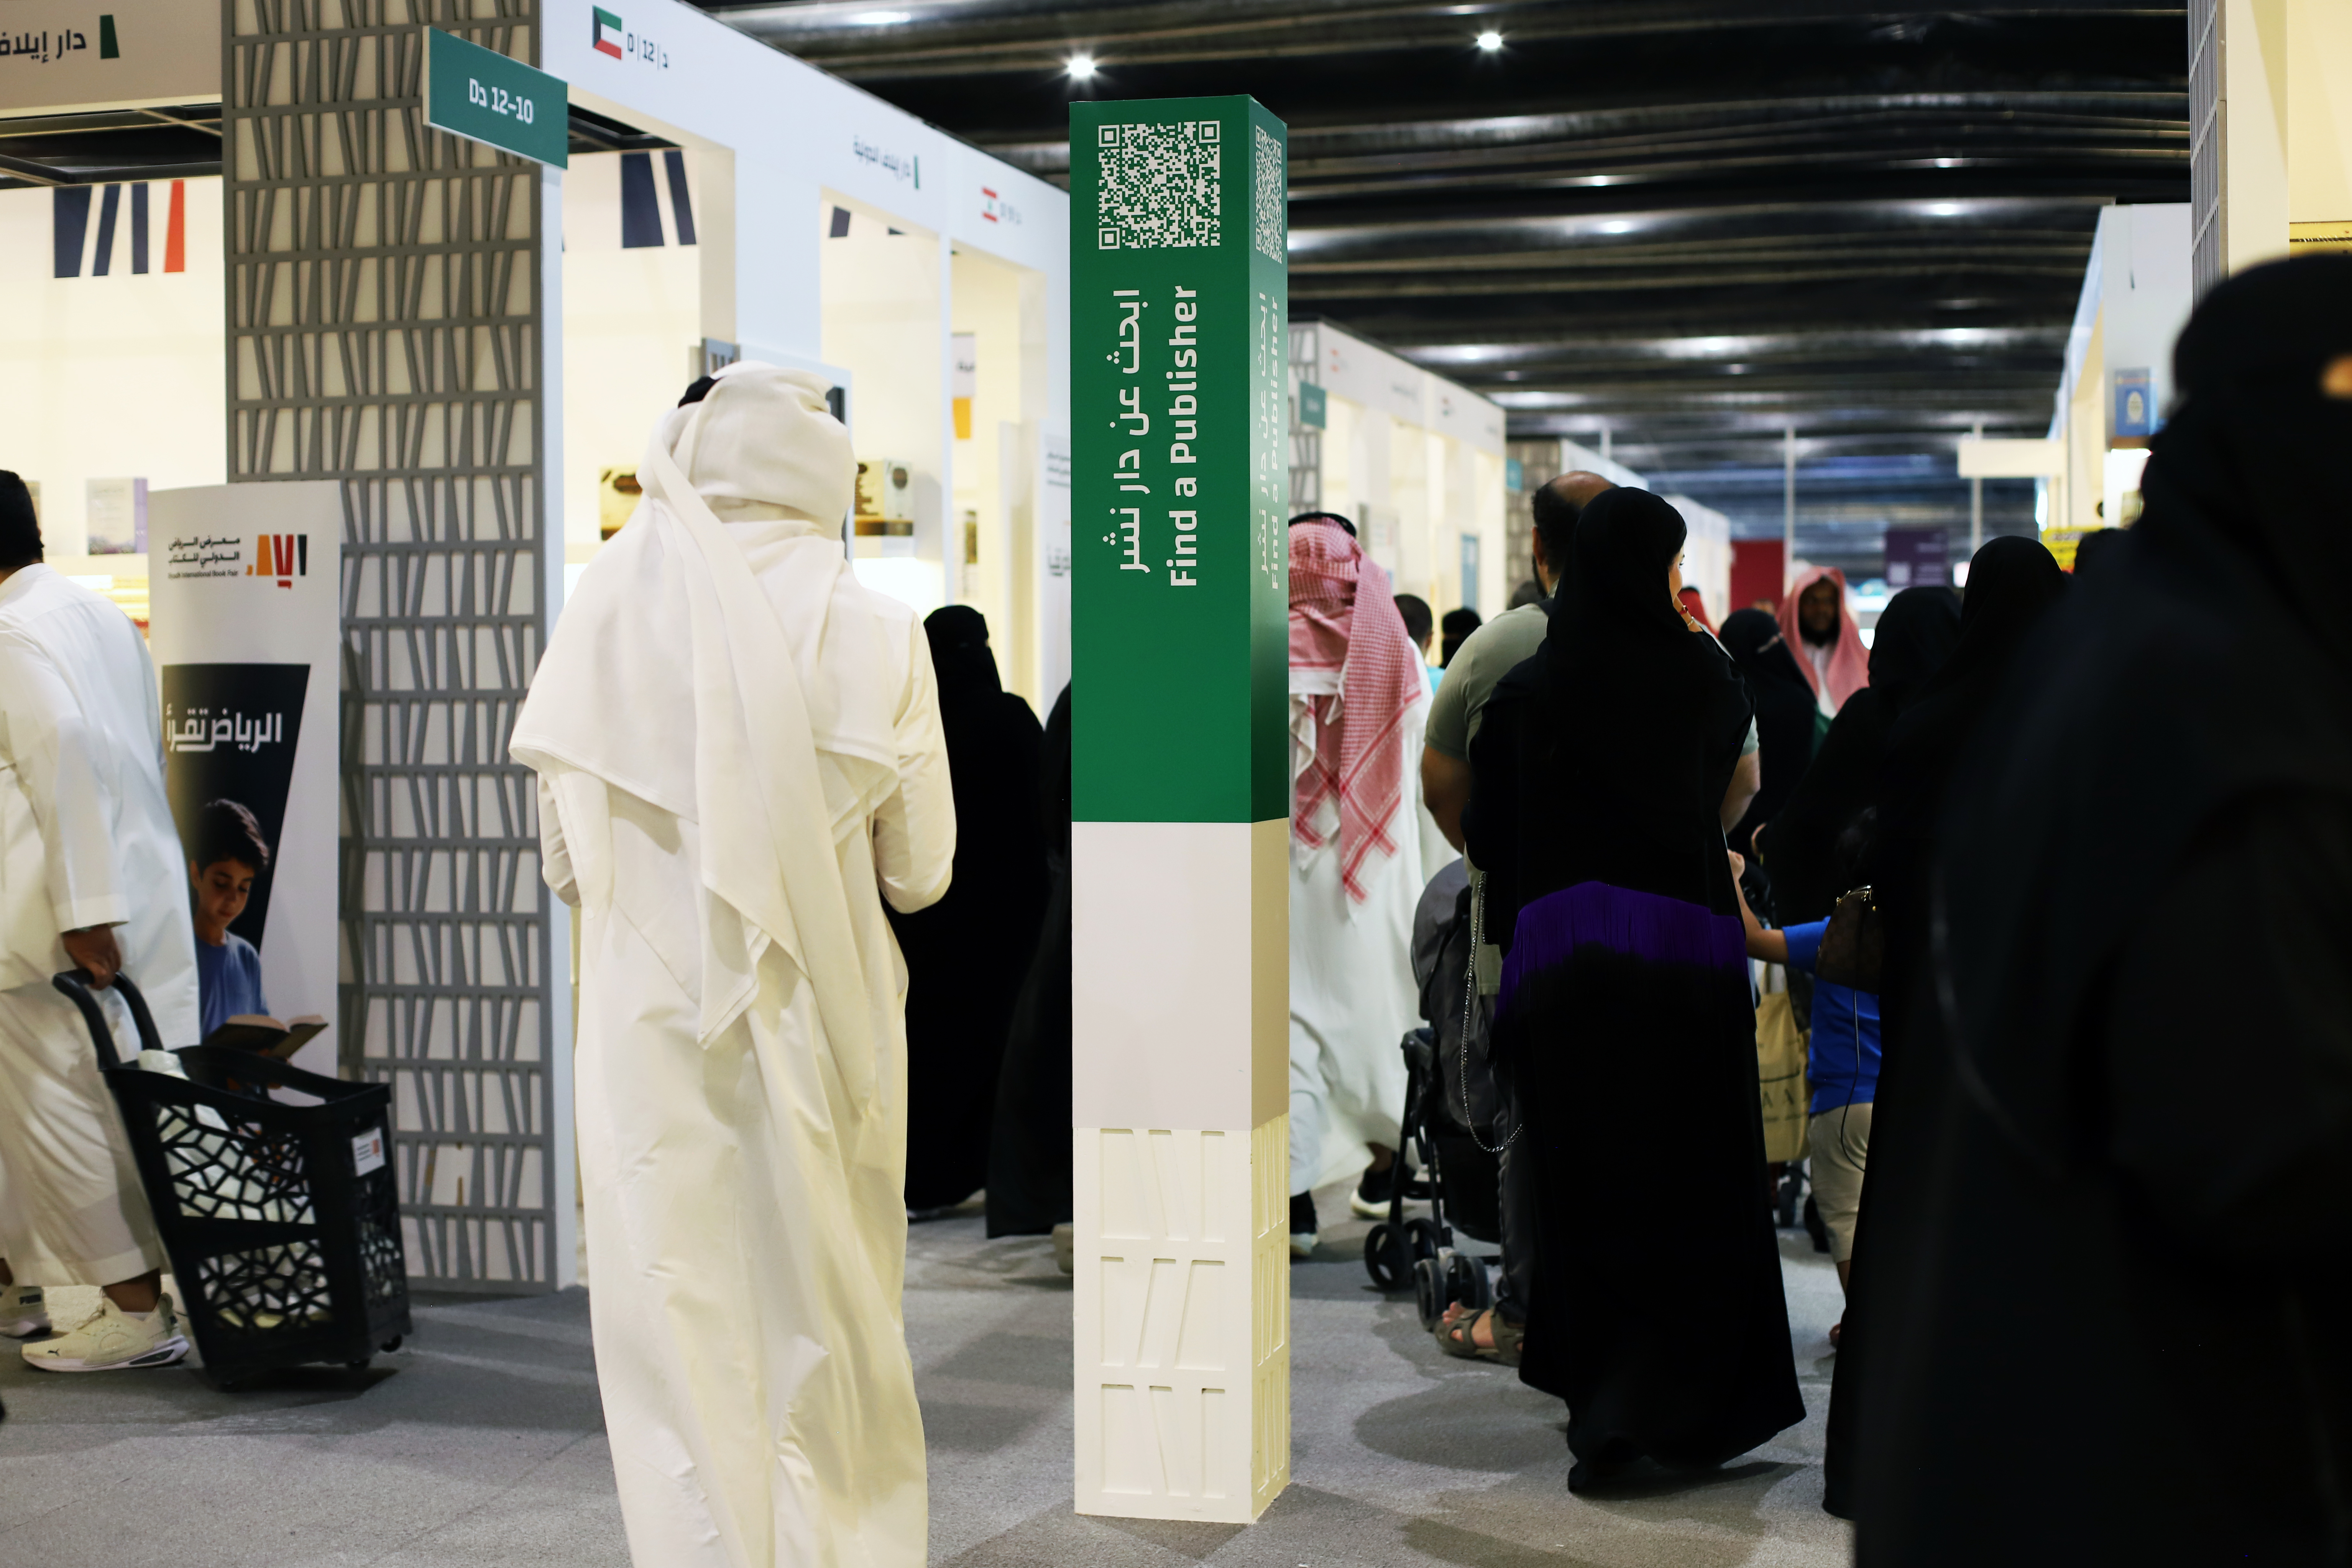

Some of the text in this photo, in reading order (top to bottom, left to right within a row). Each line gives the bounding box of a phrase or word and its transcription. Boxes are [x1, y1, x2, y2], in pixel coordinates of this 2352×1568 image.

[56, 29, 86, 59] دار
[491, 86, 534, 125] 12-10
[1103, 290, 1150, 573] ابحث عن دار نشر
[1166, 286, 1197, 586] Find a Publisher
[1257, 292, 1268, 575] ابحث عن دار نشر
[1273, 484, 1278, 503] a
